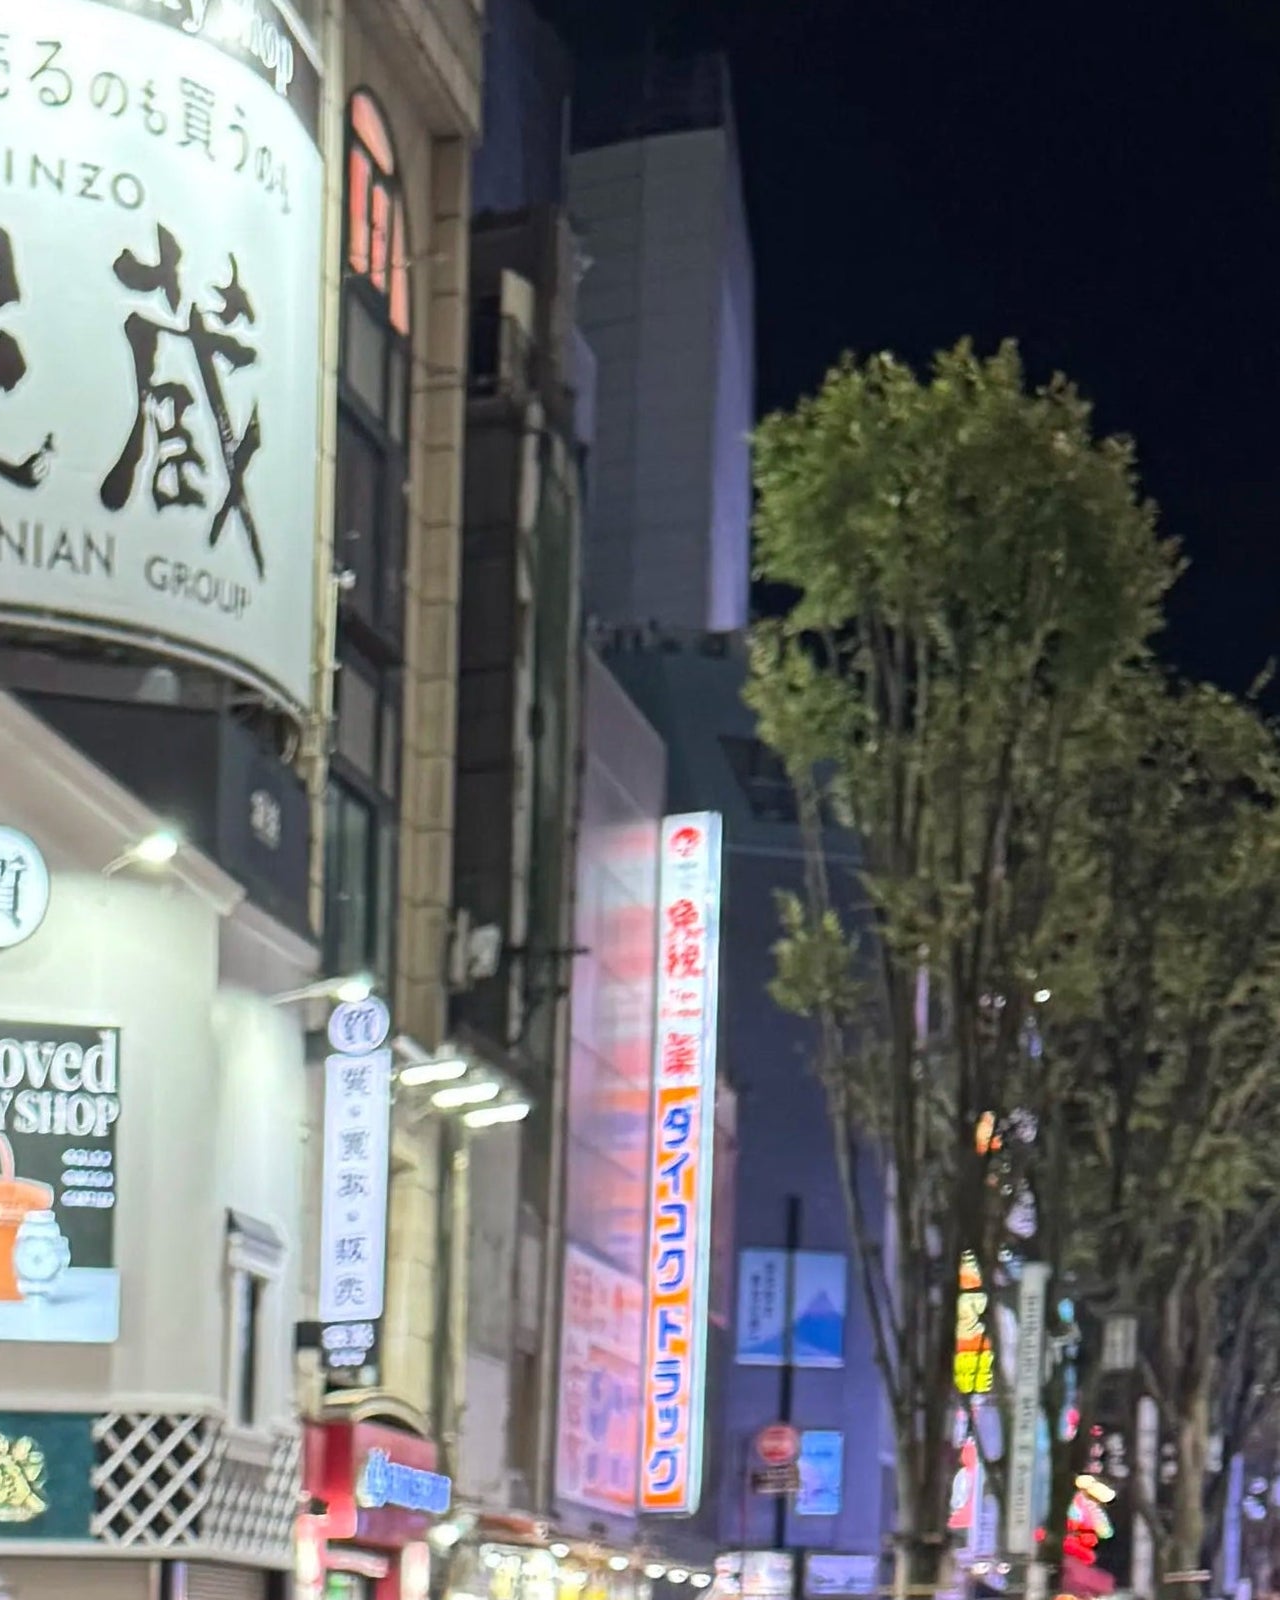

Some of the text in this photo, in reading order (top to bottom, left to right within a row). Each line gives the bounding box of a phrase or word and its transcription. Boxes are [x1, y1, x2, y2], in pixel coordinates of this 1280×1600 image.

[143, 554, 252, 621] GROUP
[13, 1088, 121, 1137] SHOP
[648, 1105, 694, 1494] ダイコクドラッグ
